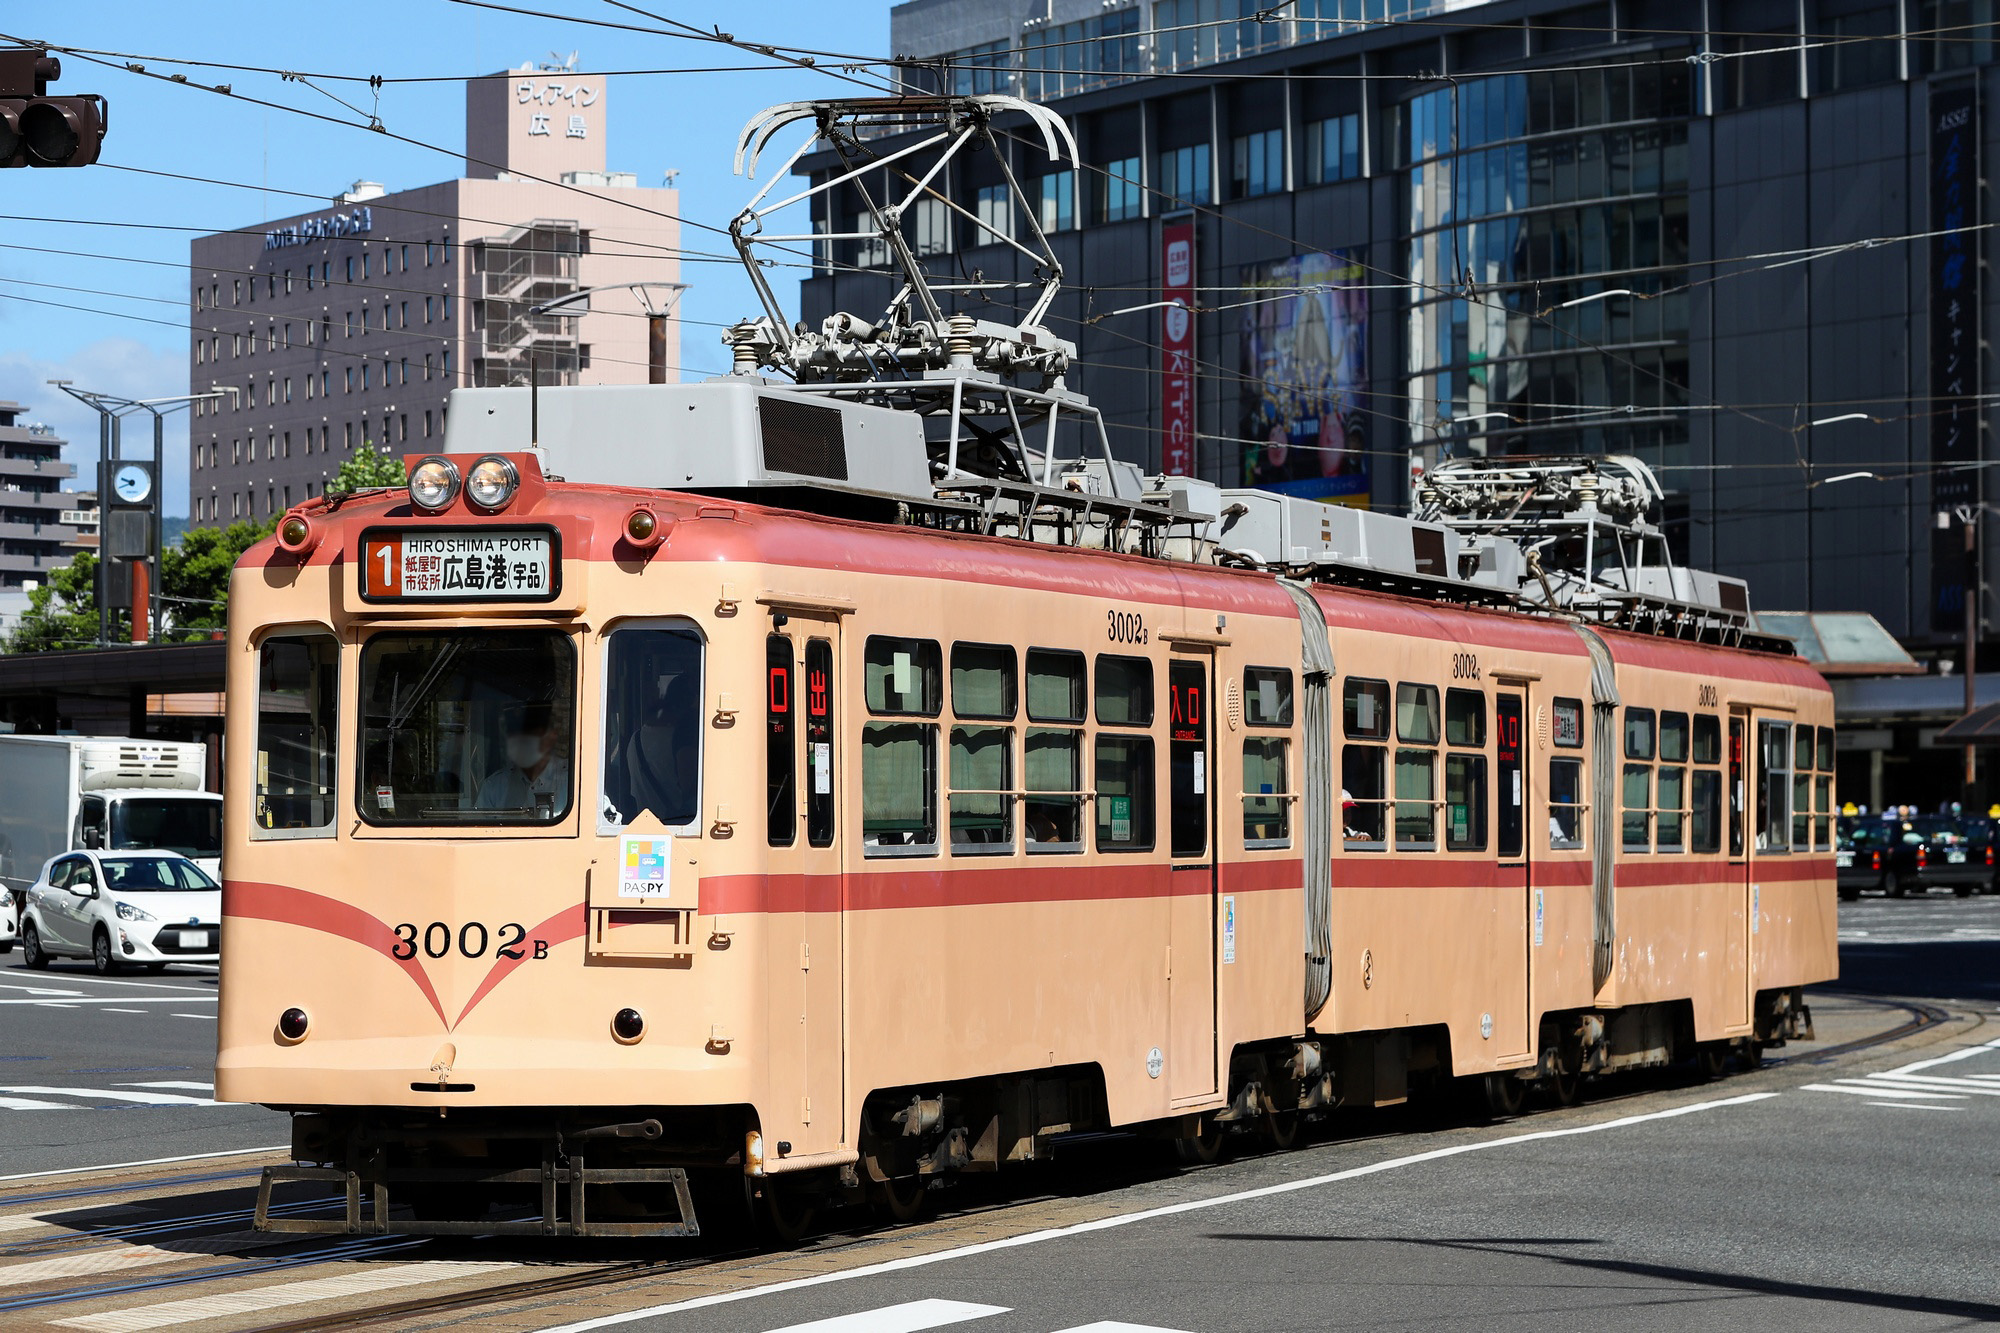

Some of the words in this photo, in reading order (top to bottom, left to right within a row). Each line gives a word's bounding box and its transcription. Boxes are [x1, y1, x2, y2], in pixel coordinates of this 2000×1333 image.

[517, 81, 599, 107] ヴィアイン
[528, 112, 587, 139] 広島
[1937, 106, 1970, 132] ASSE
[265, 226, 298, 250] HOTEL
[409, 538, 495, 553] HIROSHIMA
[500, 538, 542, 552] PORT
[376, 545, 392, 587] 1
[405, 555, 441, 573] 紙屋町
[442, 554, 546, 590] 広島港(宇品)
[405, 574, 441, 591] 市役所
[1108, 610, 1148, 645] 3002B
[1171, 685, 1199, 725] 入口
[1497, 714, 1518, 748] 入口
[624, 882, 664, 893] PASPY
